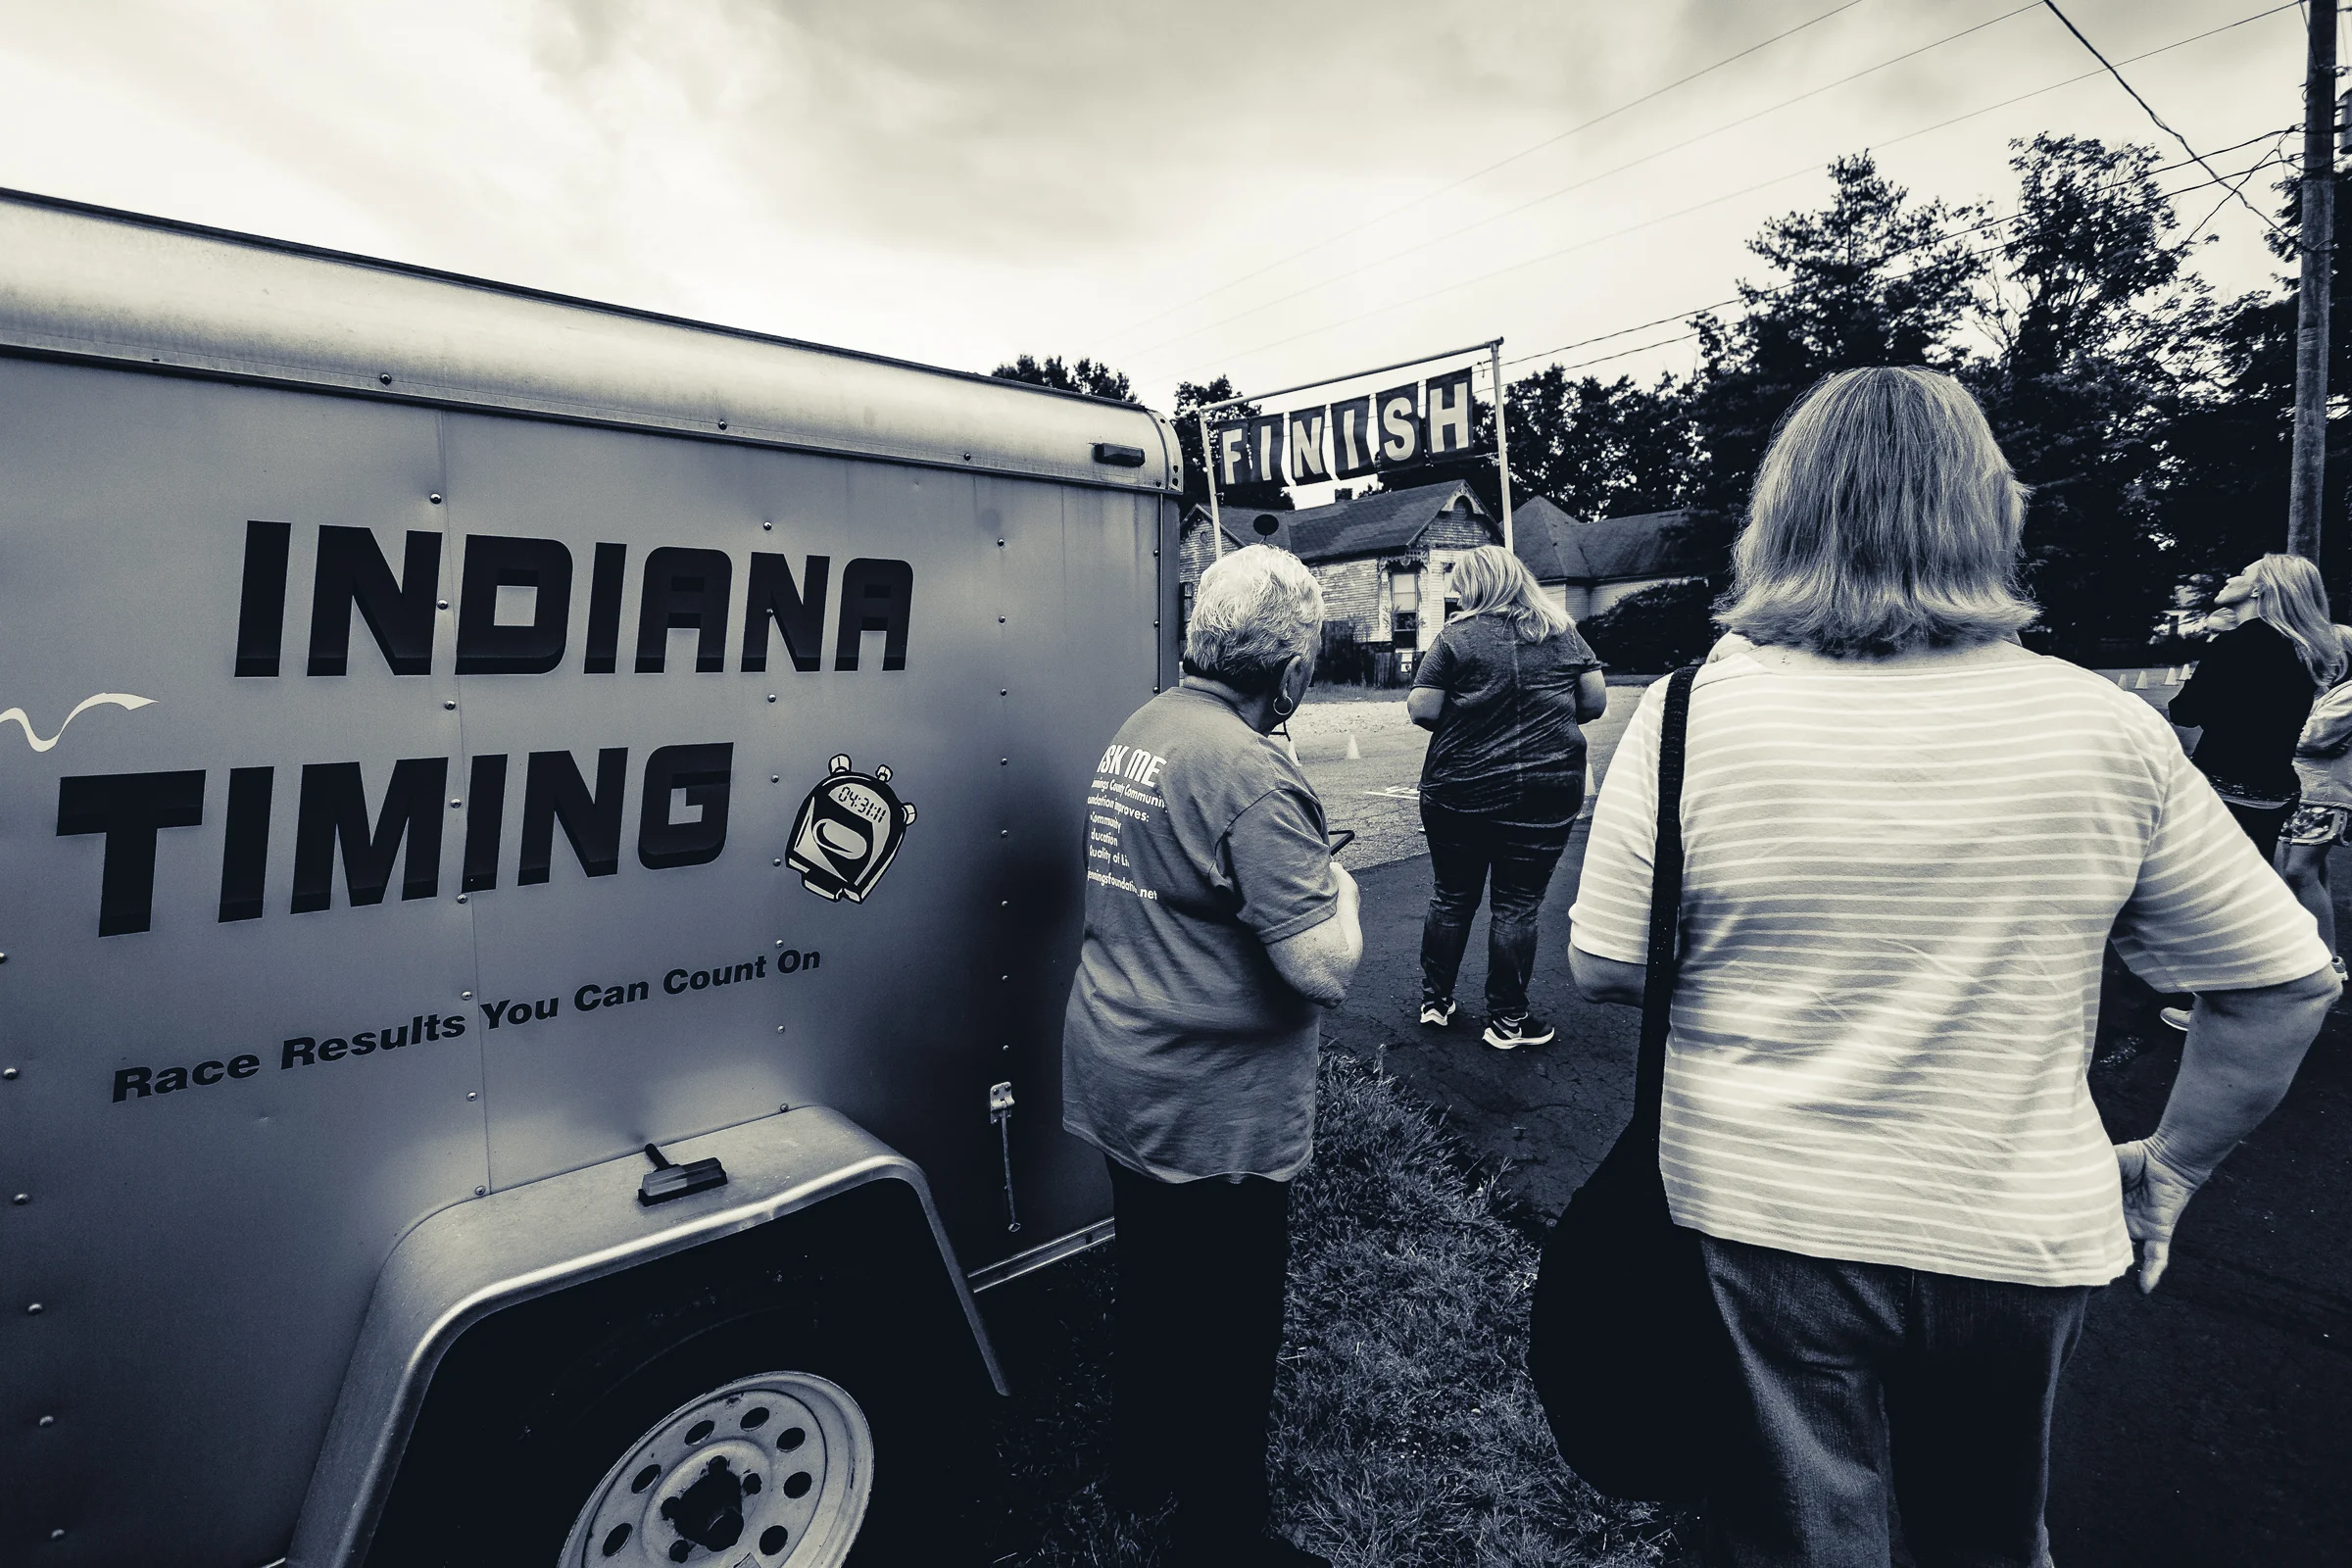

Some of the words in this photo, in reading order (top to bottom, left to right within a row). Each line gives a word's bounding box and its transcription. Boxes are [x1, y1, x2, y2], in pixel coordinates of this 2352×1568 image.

[1222, 381, 1469, 485] FINISH
[234, 520, 913, 677] INDIANA
[1109, 779, 1126, 797] County
[1124, 749, 1167, 787] ME
[56, 742, 733, 938] TIMING
[837, 786, 887, 824] 04:31:11
[1091, 827, 1118, 847] ducation
[112, 1054, 261, 1103] Race
[280, 1013, 466, 1071] Results
[480, 997, 560, 1030] You
[573, 981, 650, 1012] Can
[662, 955, 767, 995] Count
[777, 949, 821, 974] On
